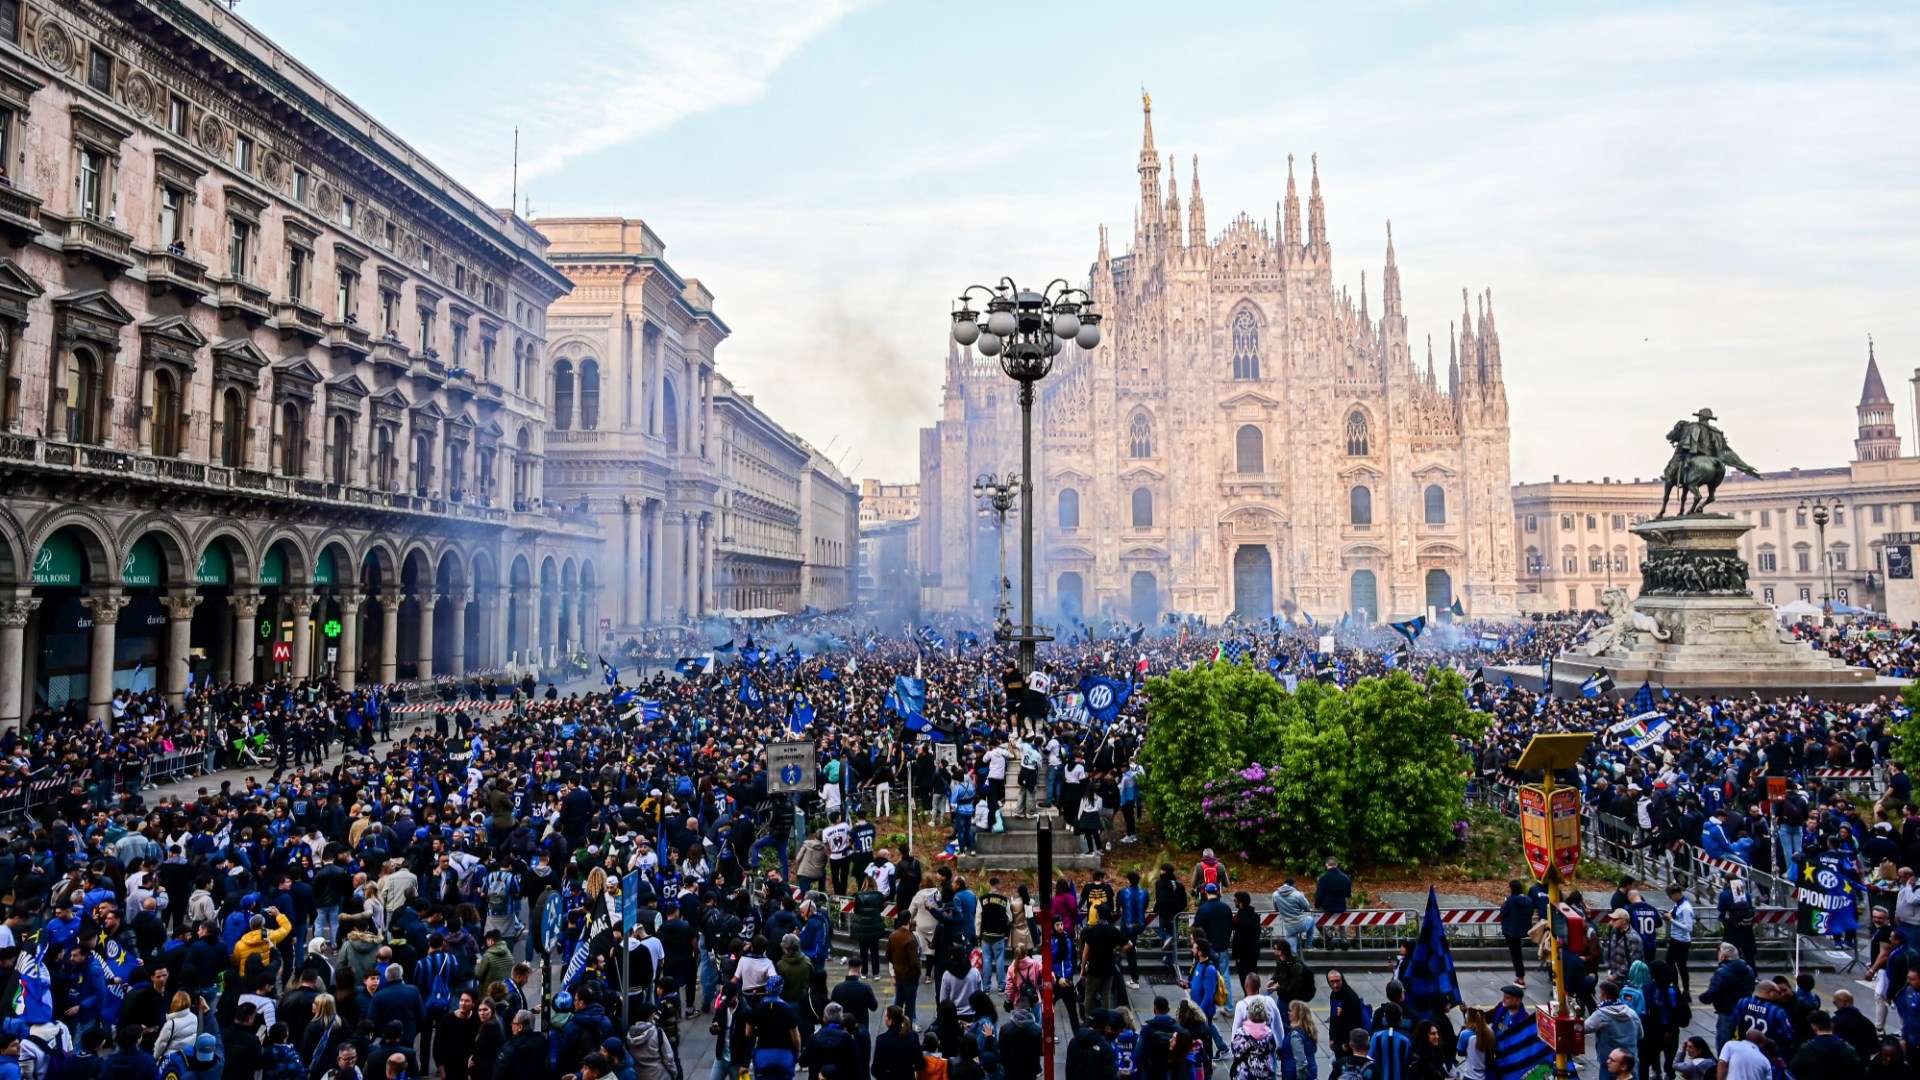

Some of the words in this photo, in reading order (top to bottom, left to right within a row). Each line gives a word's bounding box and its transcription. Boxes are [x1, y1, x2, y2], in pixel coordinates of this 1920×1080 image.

[50, 574, 70, 582] ROSSI
[275, 645, 290, 657] M
[860, 835, 873, 852] 10
[663, 884, 677, 898] 95
[1637, 916, 1655, 935] 10
